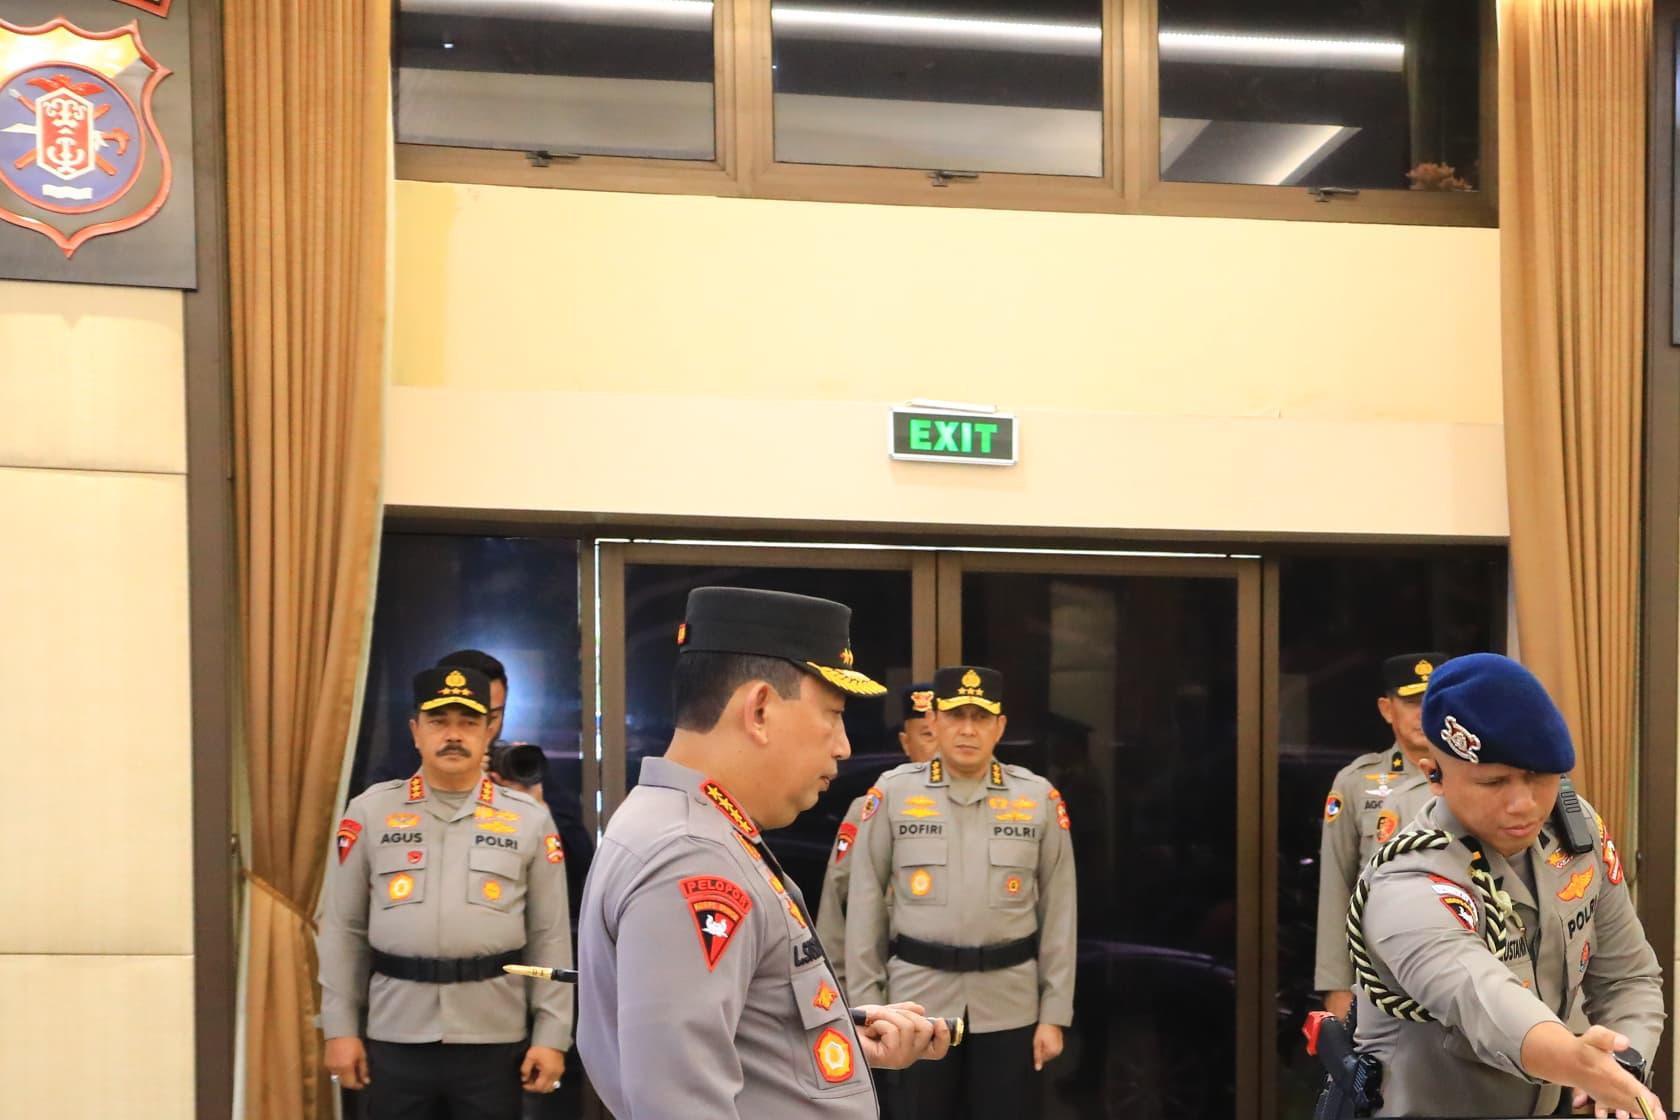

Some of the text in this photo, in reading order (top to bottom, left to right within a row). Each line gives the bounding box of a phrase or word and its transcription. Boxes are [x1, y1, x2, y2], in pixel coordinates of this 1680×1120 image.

[910, 419, 998, 453] EXIT
[899, 824, 942, 835] DOFIRI
[994, 826, 1035, 838] POLRI
[380, 832, 423, 844] AGUS
[475, 835, 518, 850] POLRI
[687, 880, 749, 908] PELOPOR
